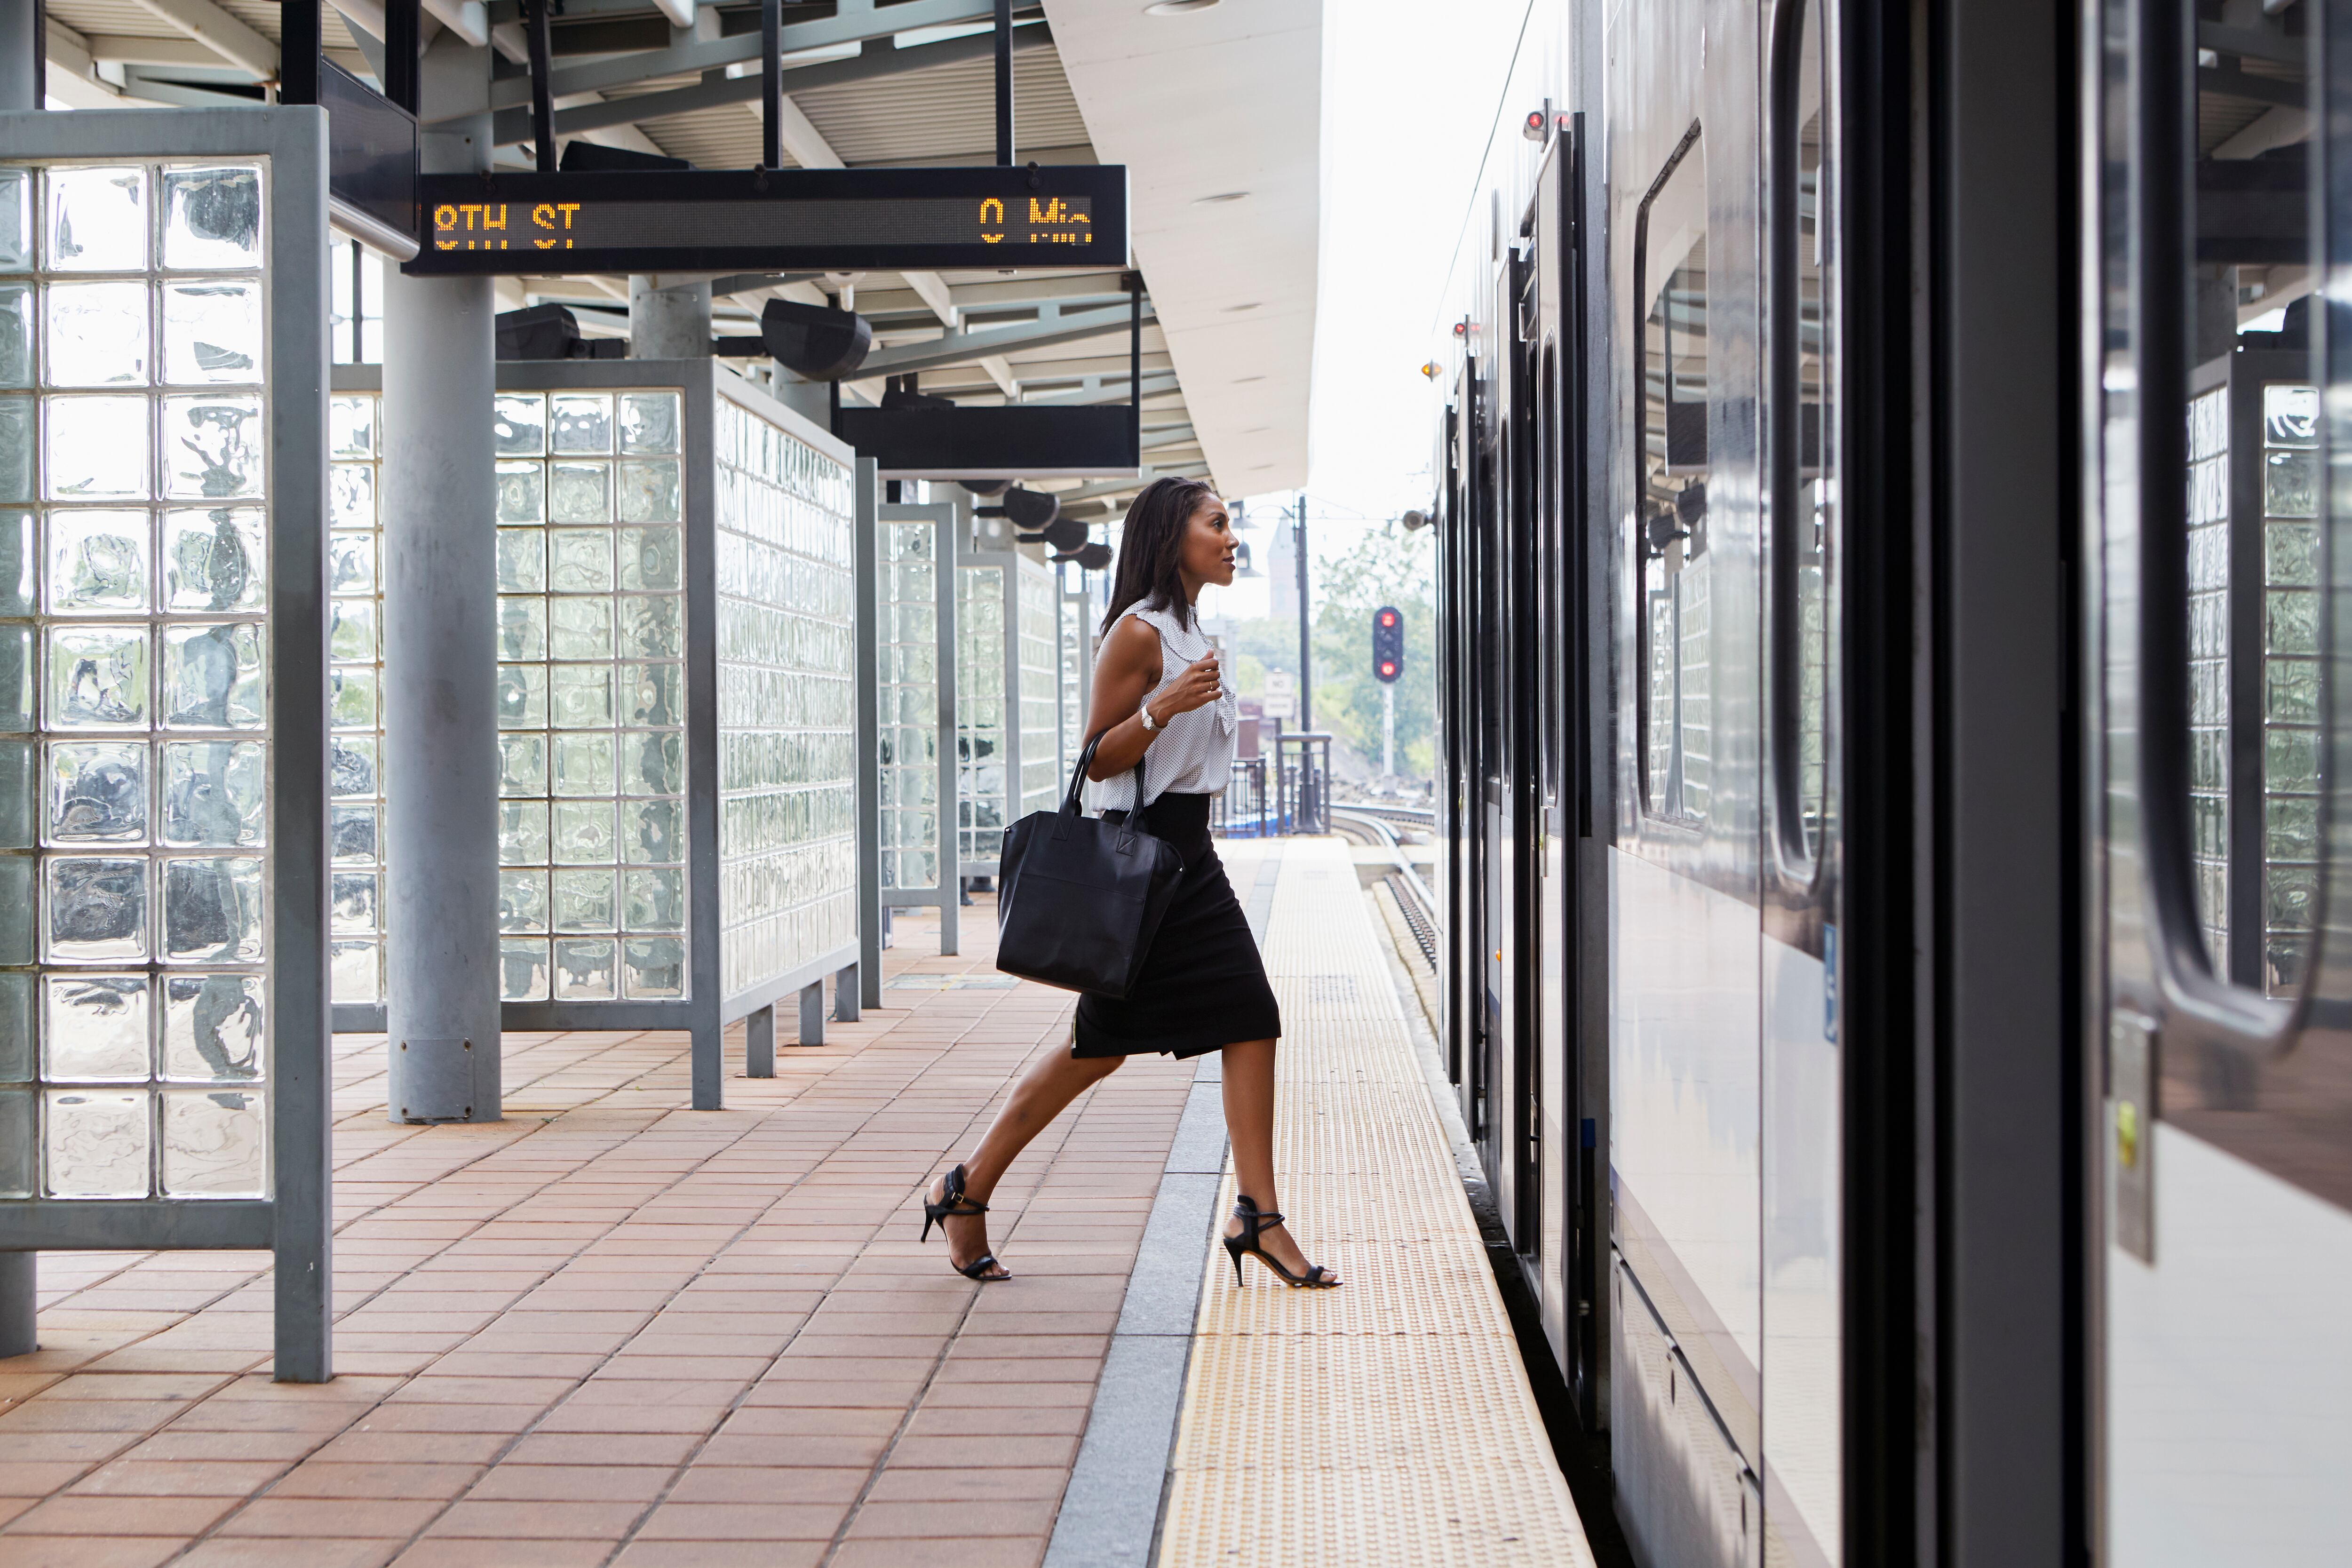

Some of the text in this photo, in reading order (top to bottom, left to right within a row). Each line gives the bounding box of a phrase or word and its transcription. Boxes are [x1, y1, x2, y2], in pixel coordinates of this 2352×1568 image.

[532, 203, 580, 249] ST
[980, 198, 1004, 243] 0
[1029, 197, 1092, 243] Min
